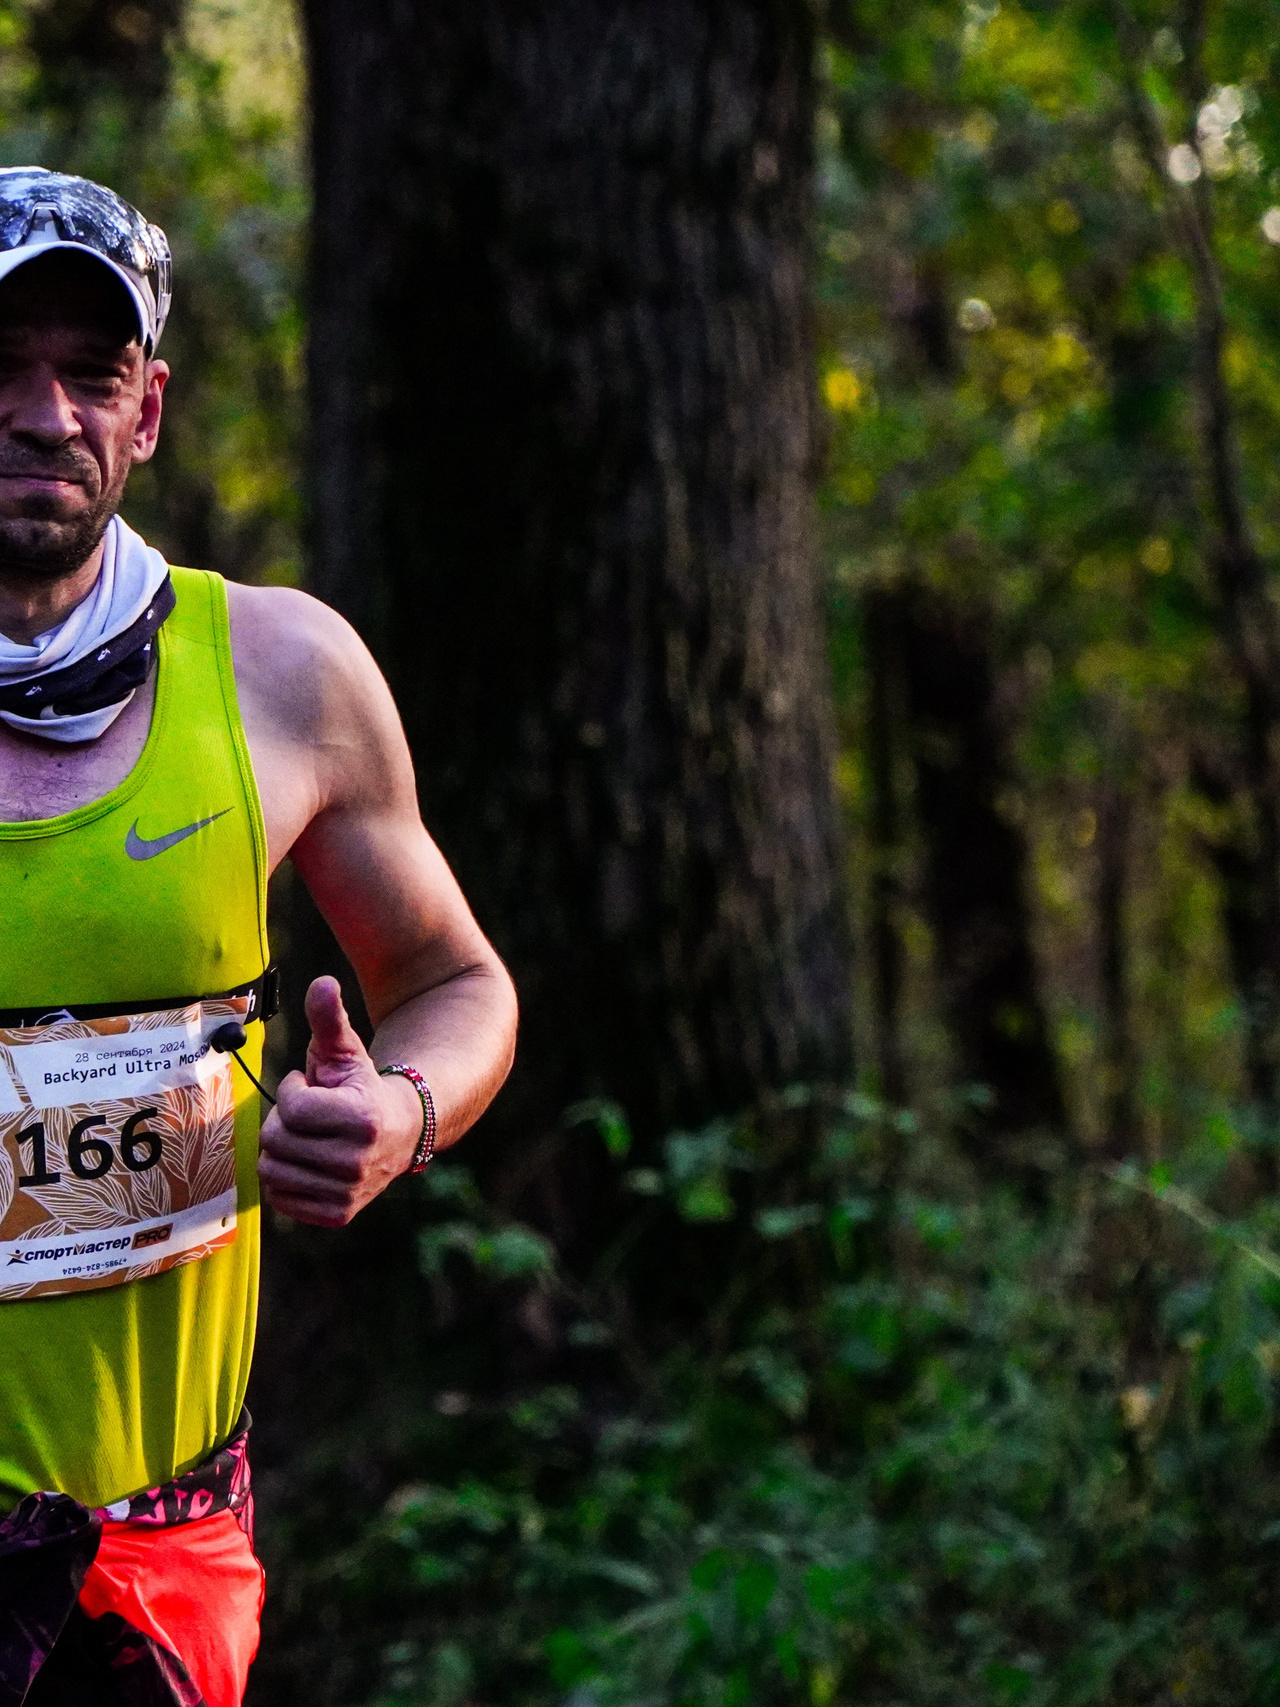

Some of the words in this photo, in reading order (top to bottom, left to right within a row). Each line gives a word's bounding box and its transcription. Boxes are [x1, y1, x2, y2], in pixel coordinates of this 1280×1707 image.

[75, 1052, 90, 1063] 28
[96, 1046, 153, 1061] сентября
[160, 1040, 186, 1054] 2024
[44, 1064, 117, 1085] Backyard
[125, 1058, 171, 1074] Ultra
[15, 1107, 163, 1187] 166
[134, 1227, 171, 1248] PRO
